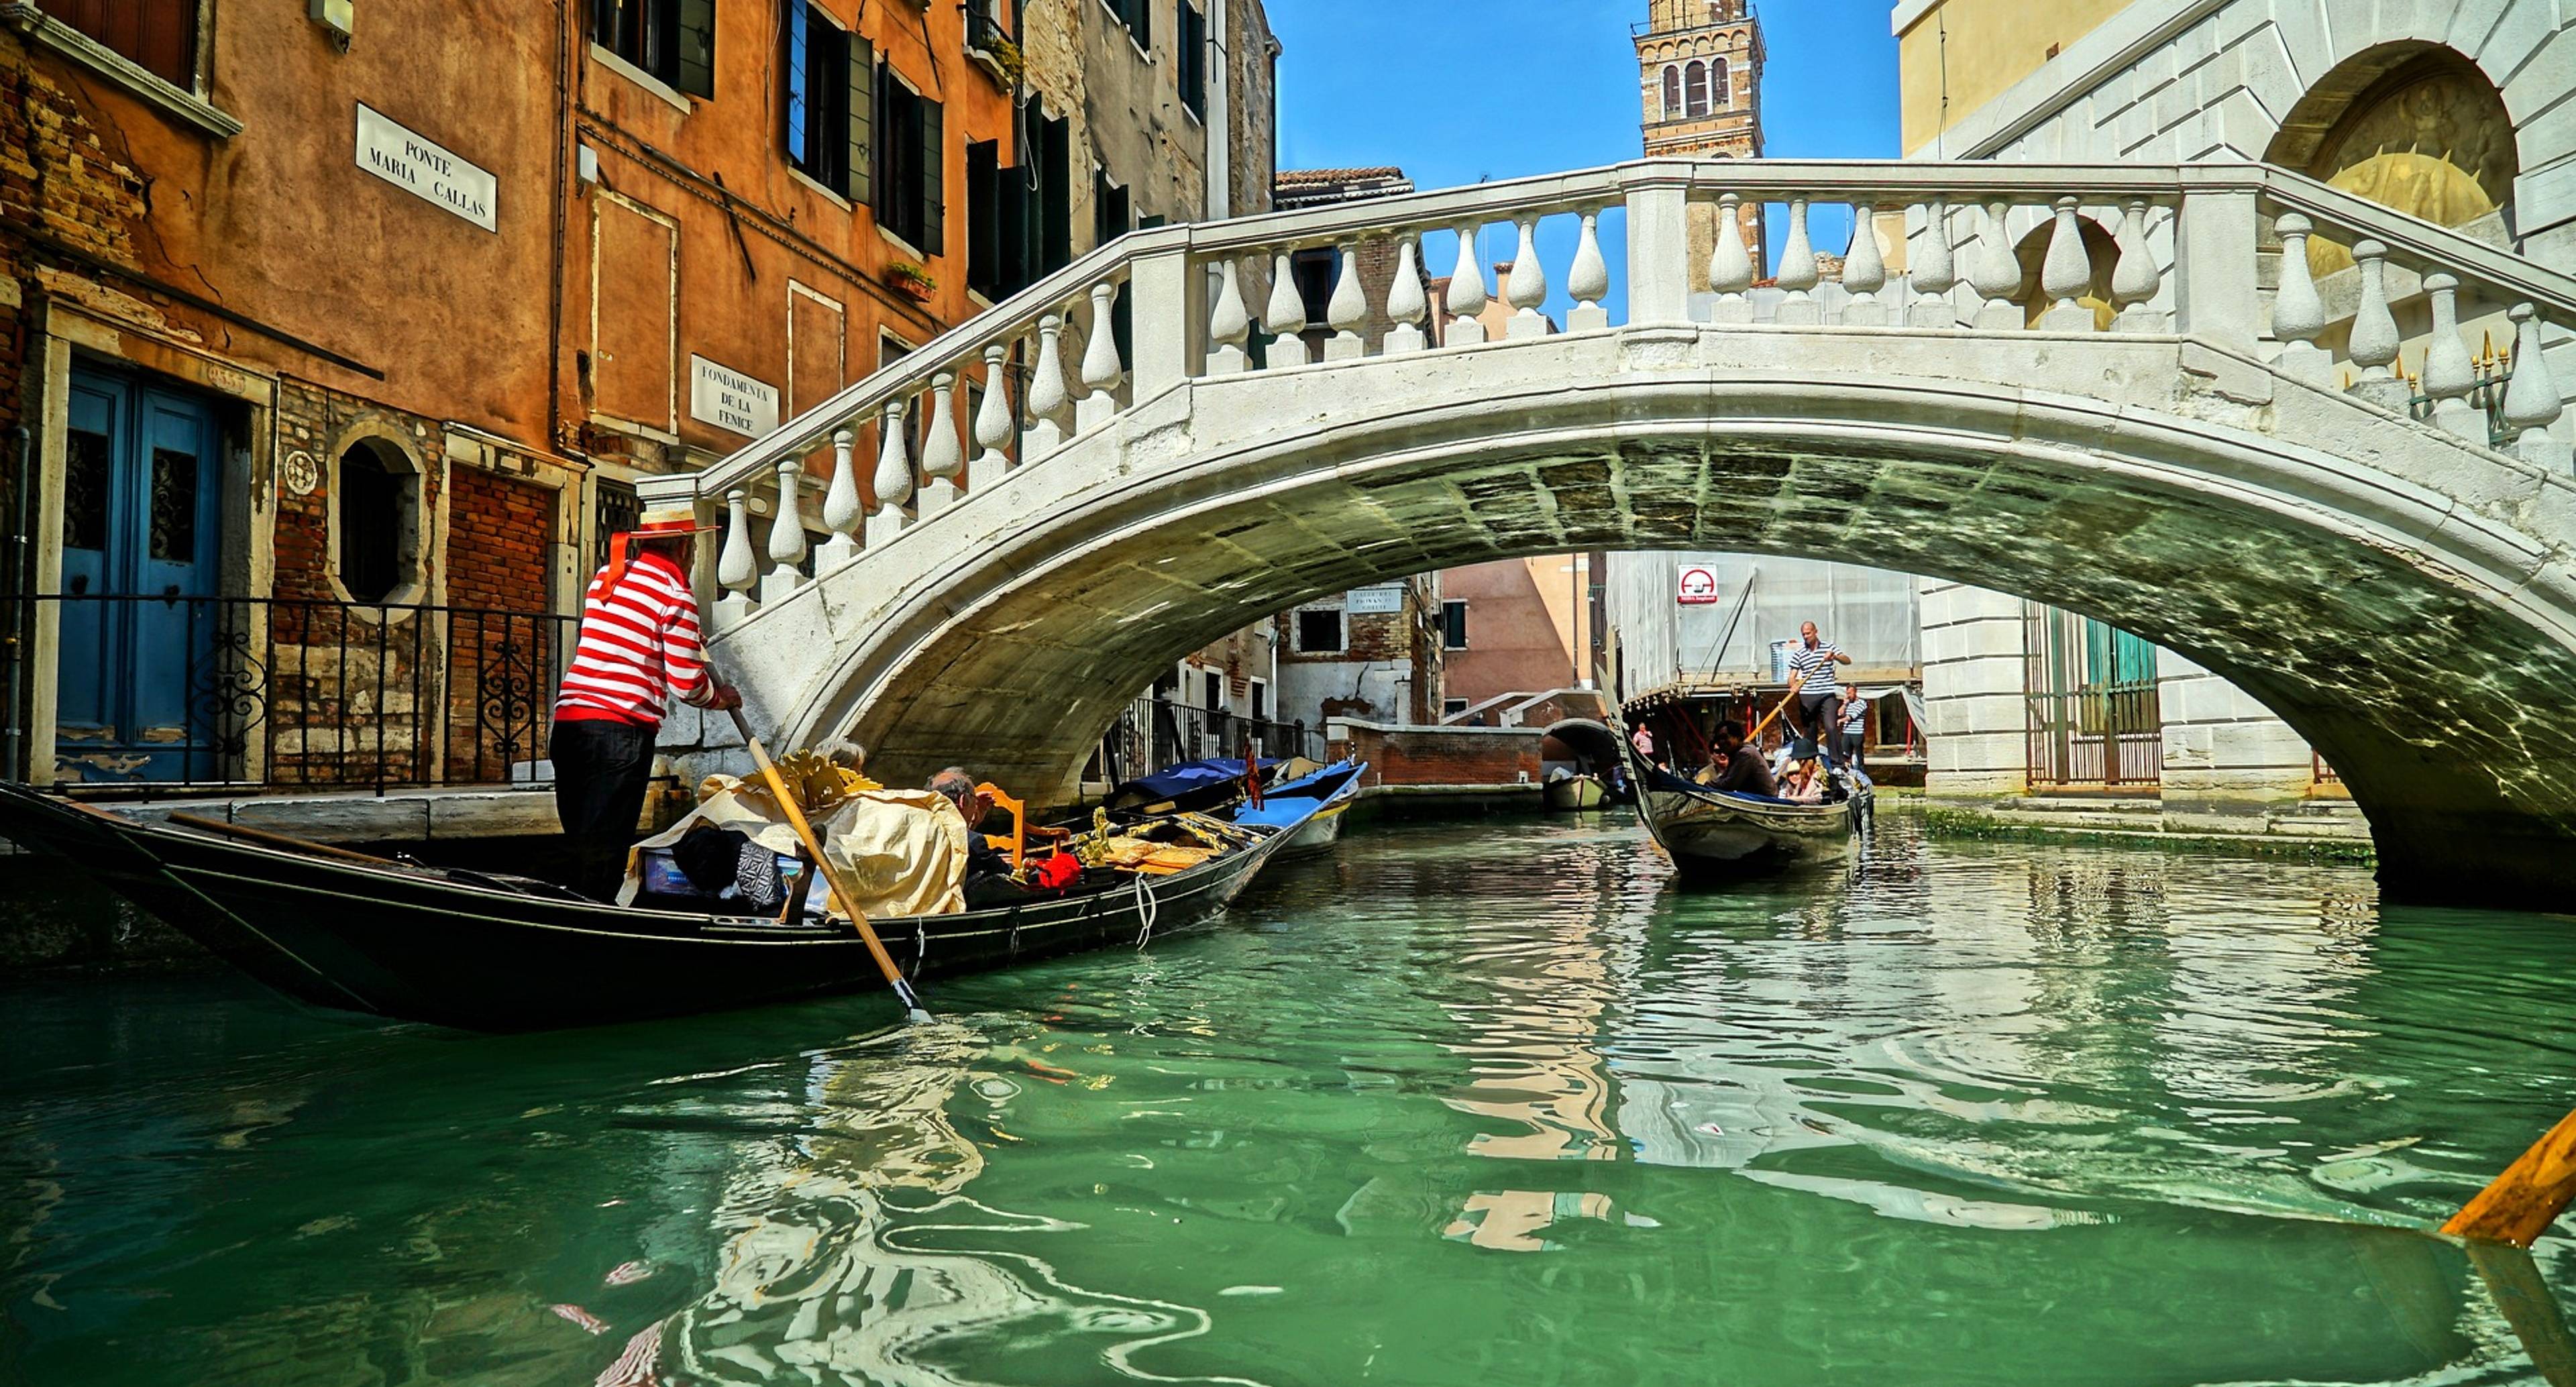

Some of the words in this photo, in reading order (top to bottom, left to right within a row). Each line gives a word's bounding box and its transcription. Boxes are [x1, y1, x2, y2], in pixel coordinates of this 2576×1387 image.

[405, 140, 451, 177] PONTE
[370, 147, 416, 184] MARIA
[433, 181, 486, 218] CALLAS
[702, 366, 767, 402] FONDAMENTA
[718, 409, 753, 432] FENICE
[721, 392, 735, 408] DE
[738, 398, 751, 413] LA
